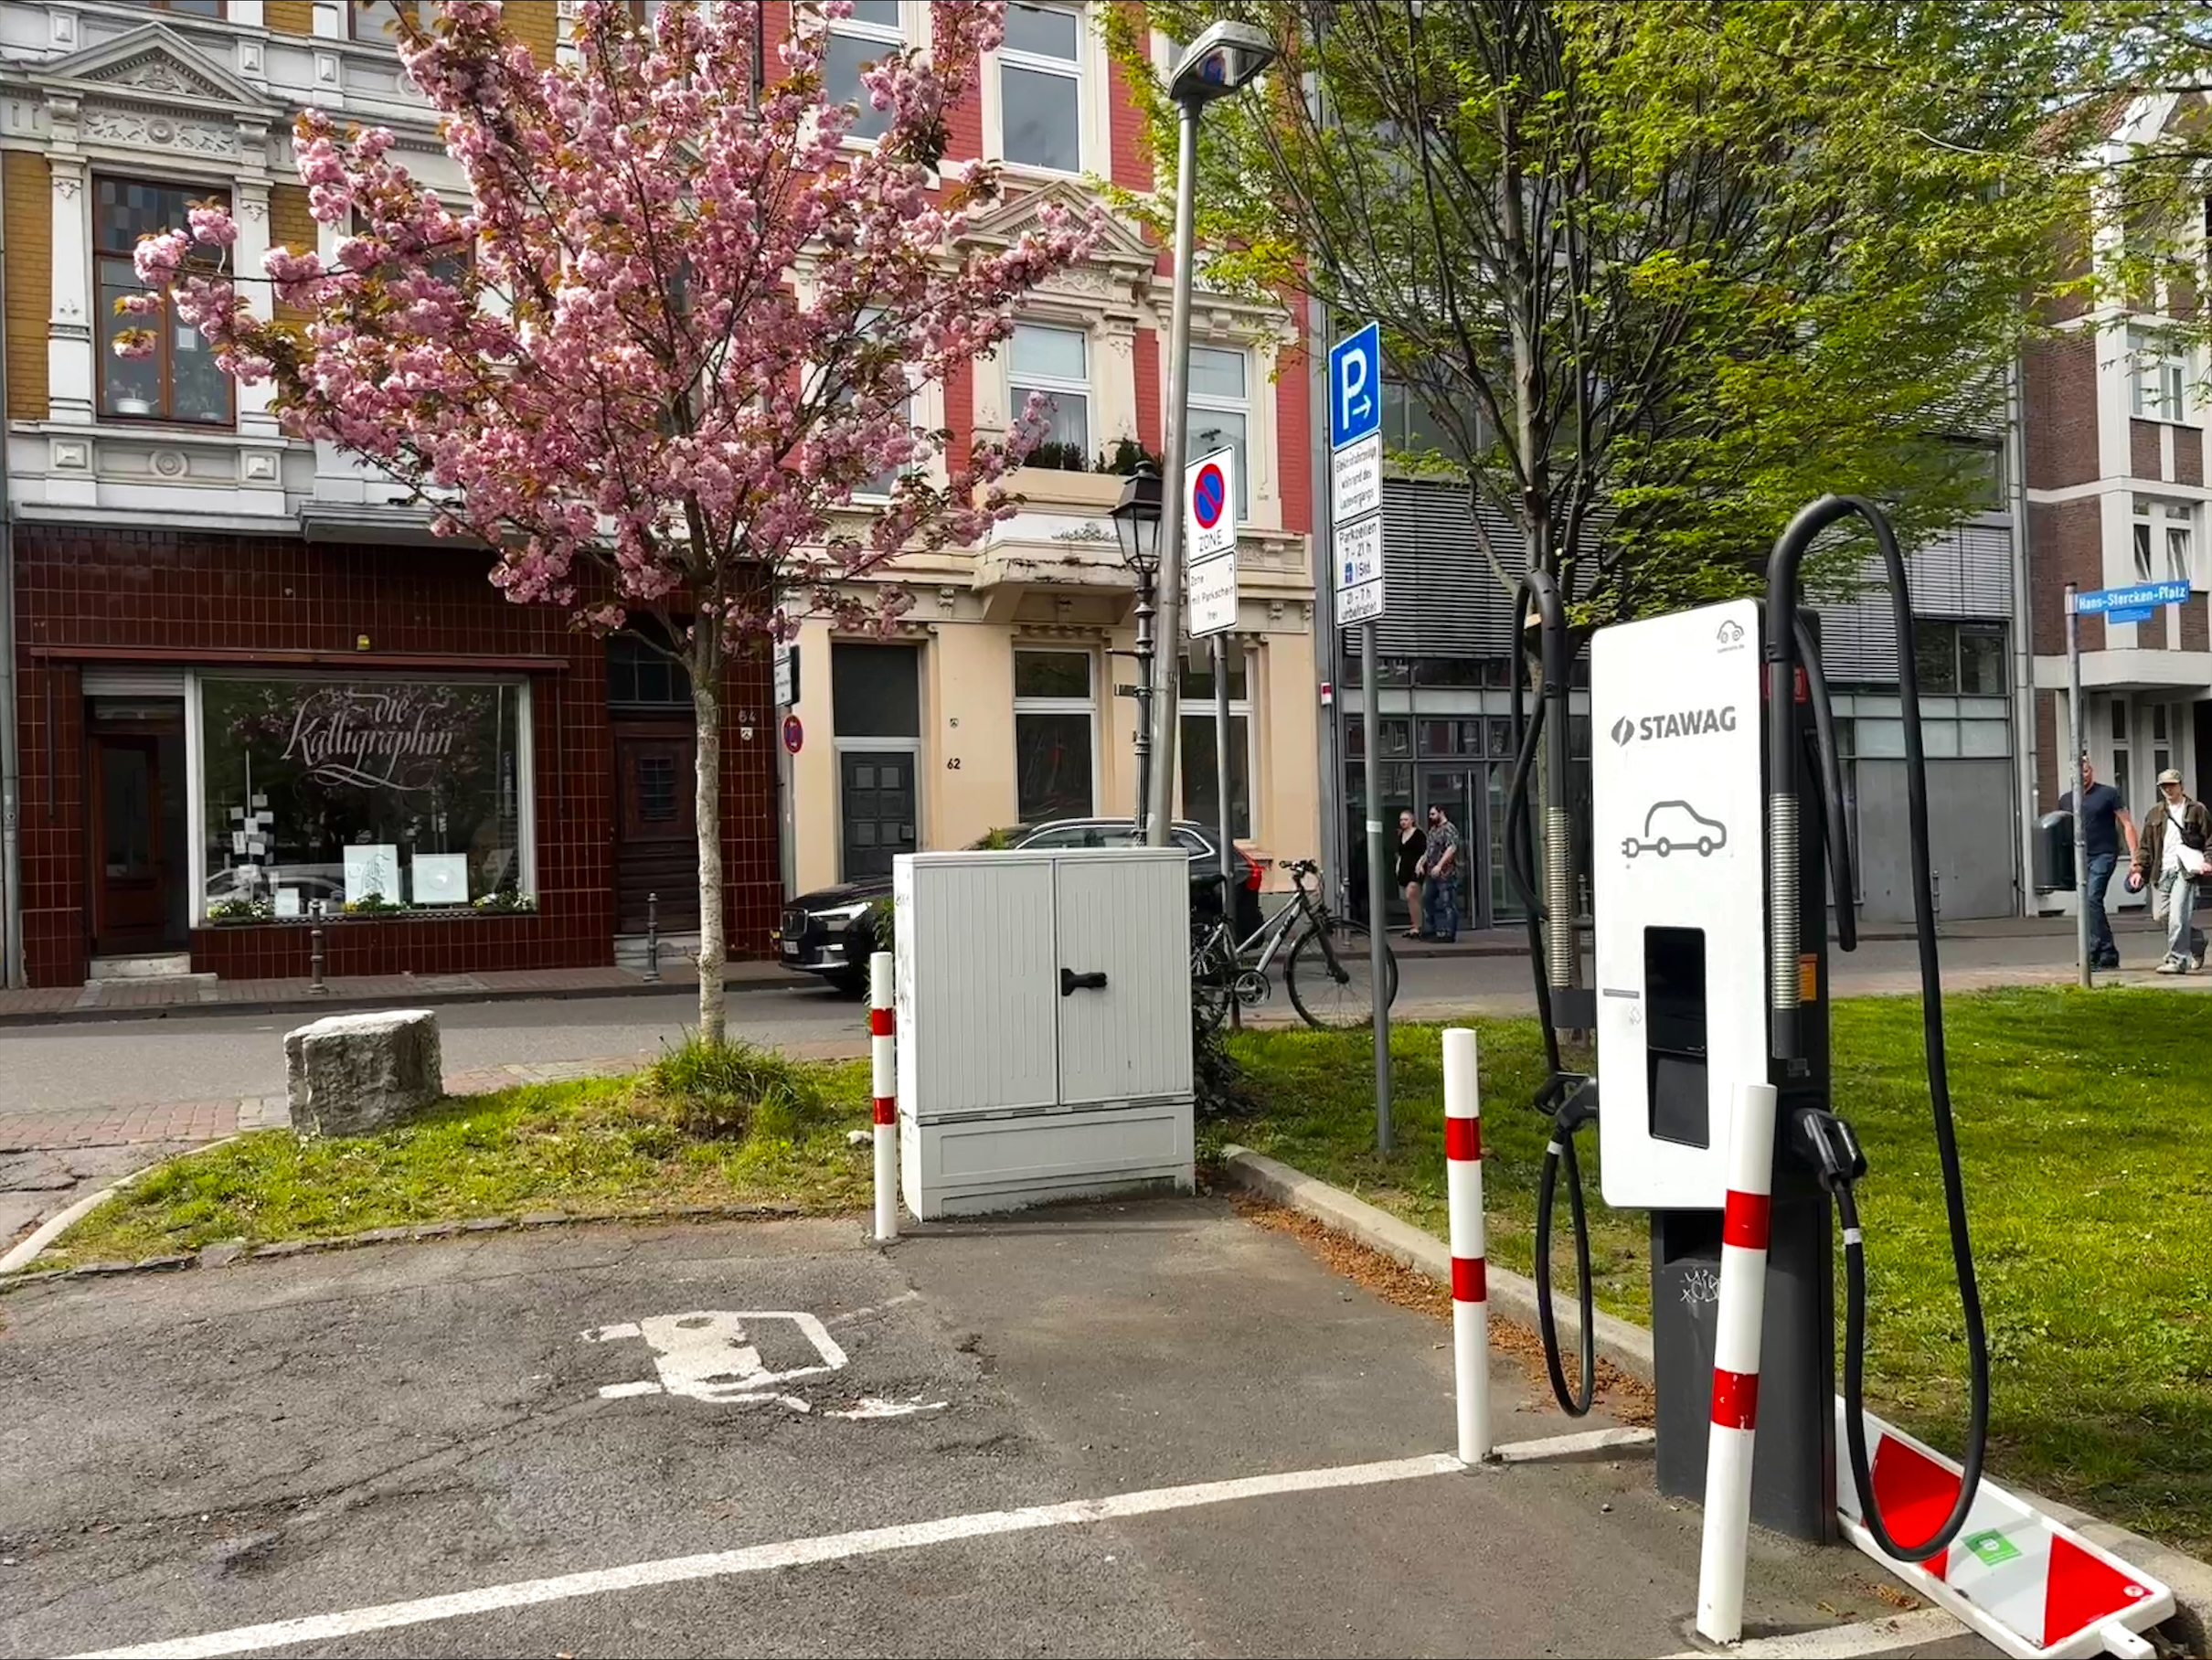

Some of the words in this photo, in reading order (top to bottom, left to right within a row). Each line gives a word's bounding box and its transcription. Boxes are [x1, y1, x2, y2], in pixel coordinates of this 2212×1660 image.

[1341, 347, 1367, 430] P
[1198, 529, 1223, 552] ZONE
[2079, 585, 2186, 611] Hans-Stercken-Platz
[1640, 706, 1737, 741] STAWAG
[280, 693, 454, 786] Kalligraphin
[947, 758, 961, 770] 62
